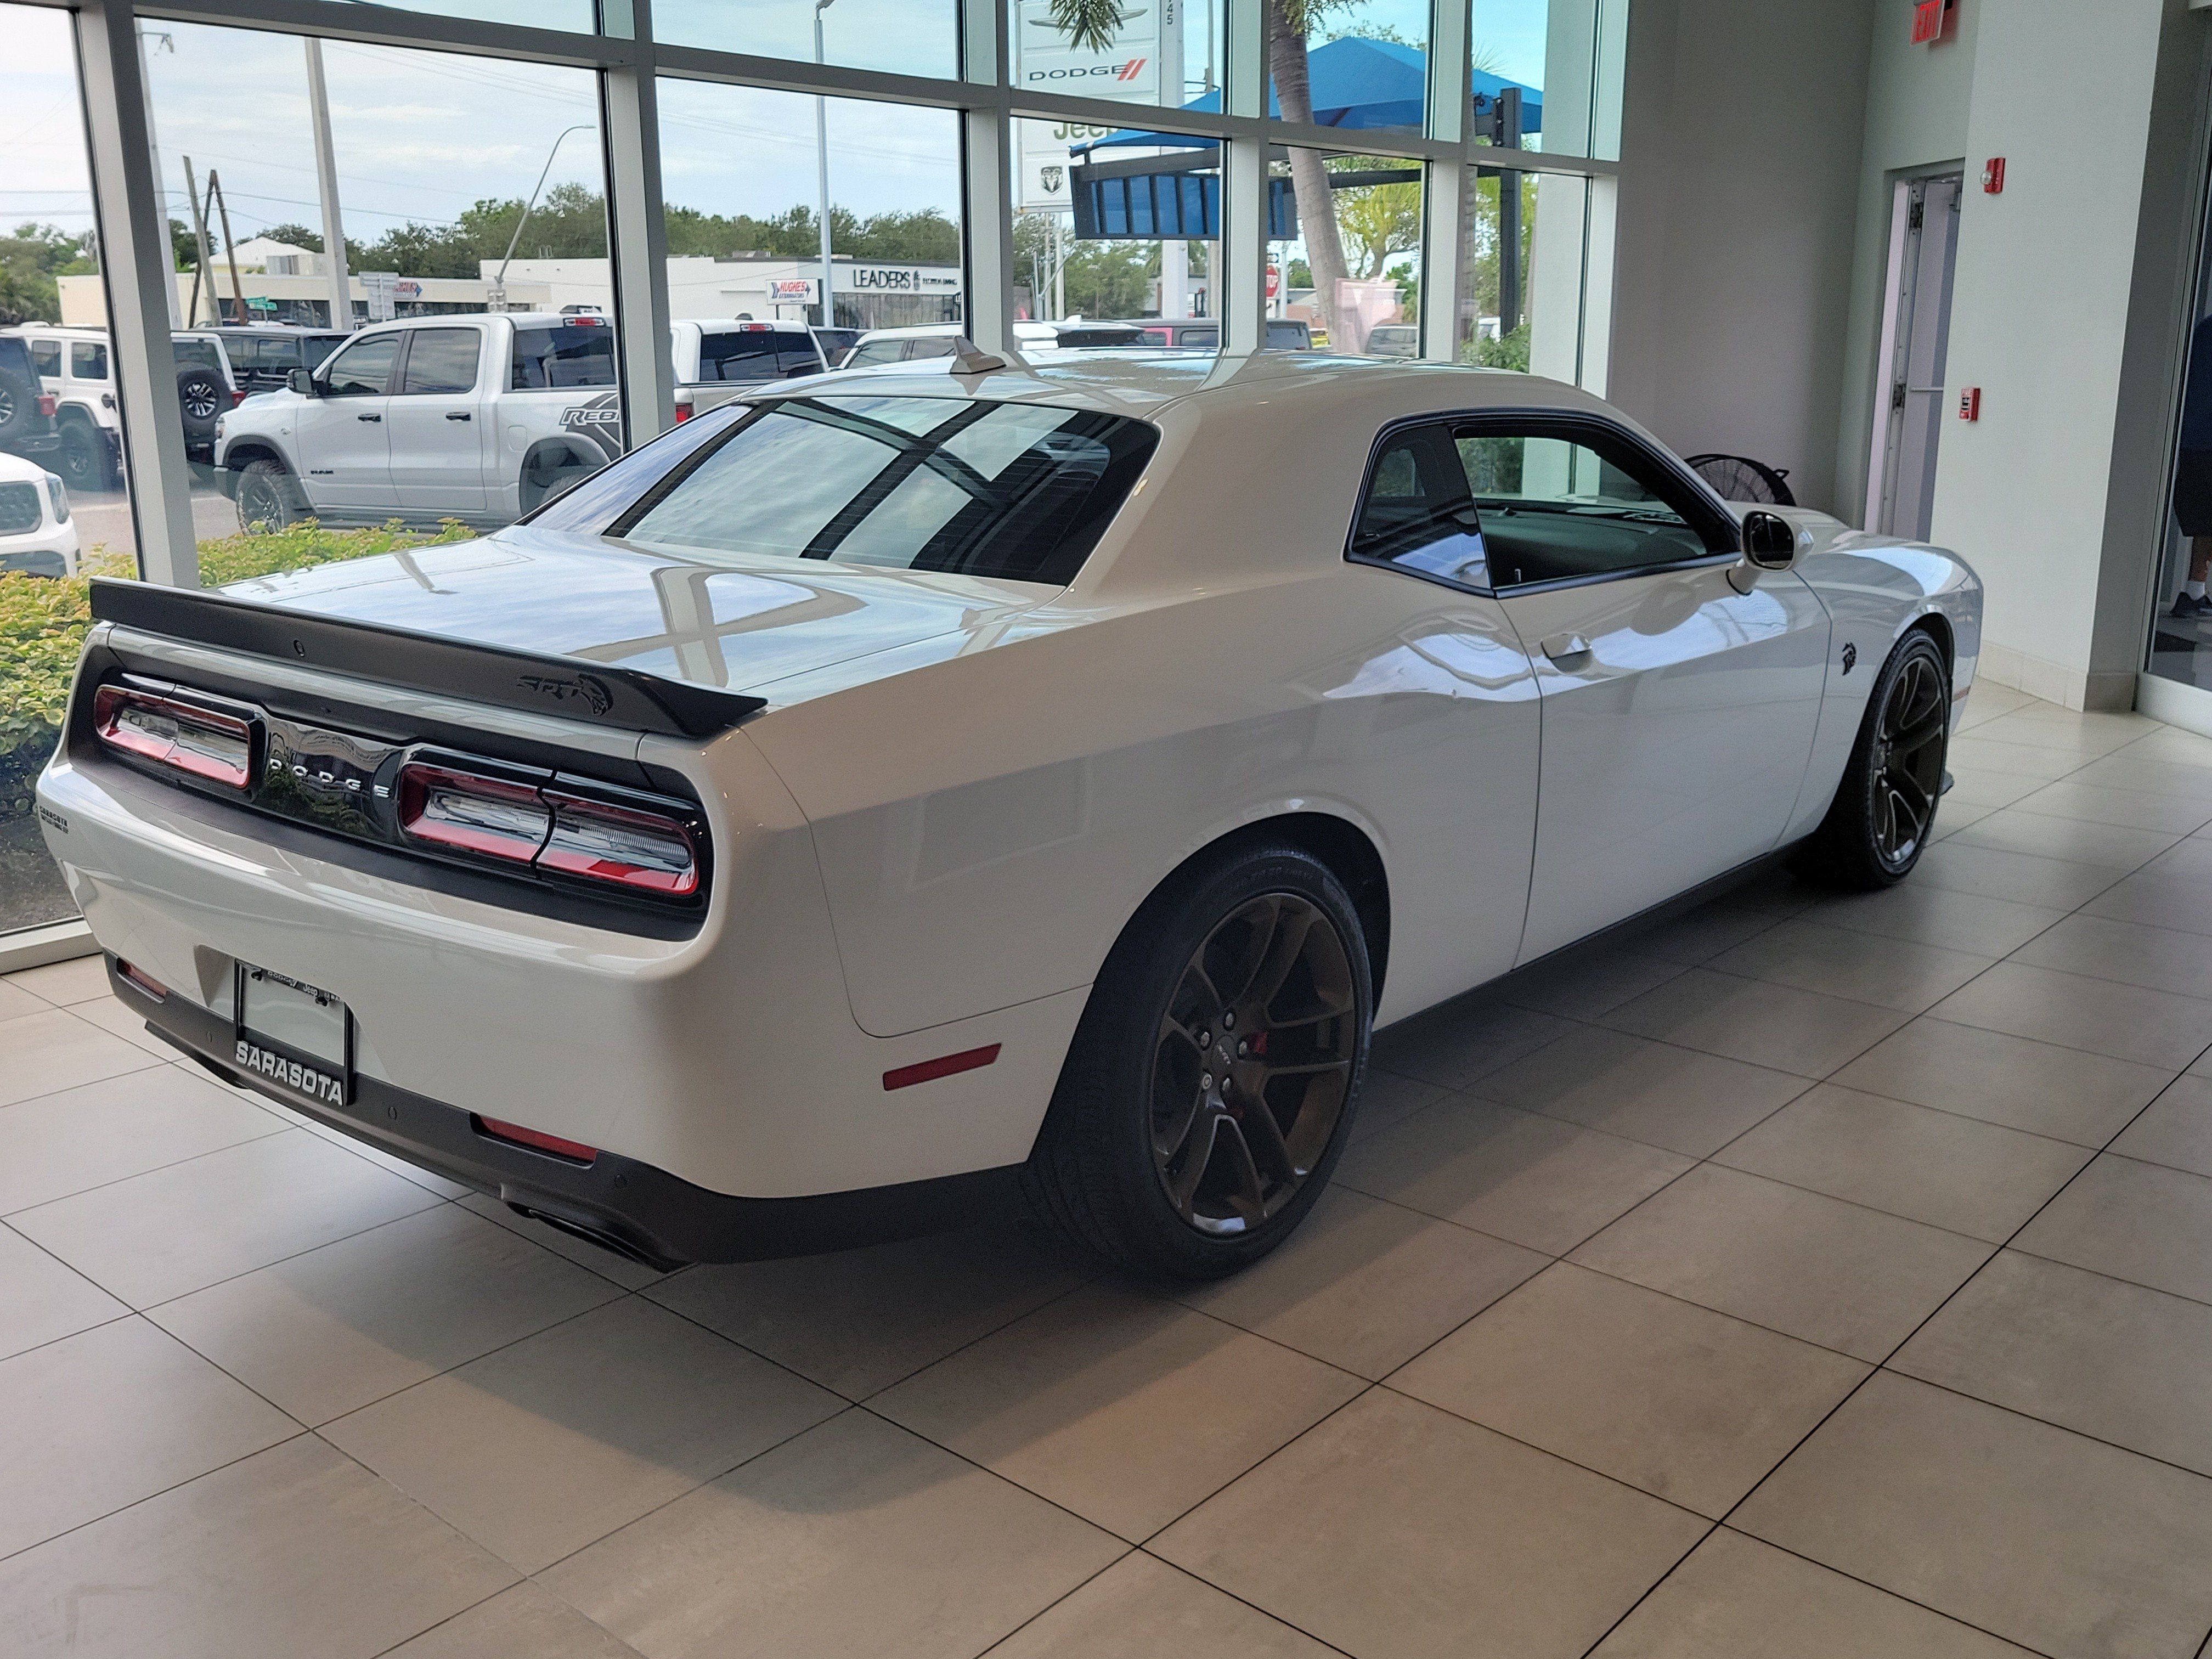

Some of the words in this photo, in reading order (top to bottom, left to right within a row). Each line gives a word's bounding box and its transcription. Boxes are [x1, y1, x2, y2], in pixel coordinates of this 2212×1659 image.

[1029, 64, 1129, 81] DODGE
[780, 281, 806, 292] HUGHES
[853, 269, 911, 289] LEADERS
[1266, 275, 1279, 289] TOP
[561, 408, 619, 425] REB
[517, 675, 579, 699] SRT
[269, 758, 390, 798] DODGE
[267, 970, 293, 984] DODGE
[303, 984, 318, 997] Jeep
[235, 1041, 343, 1107] SARASOTA
